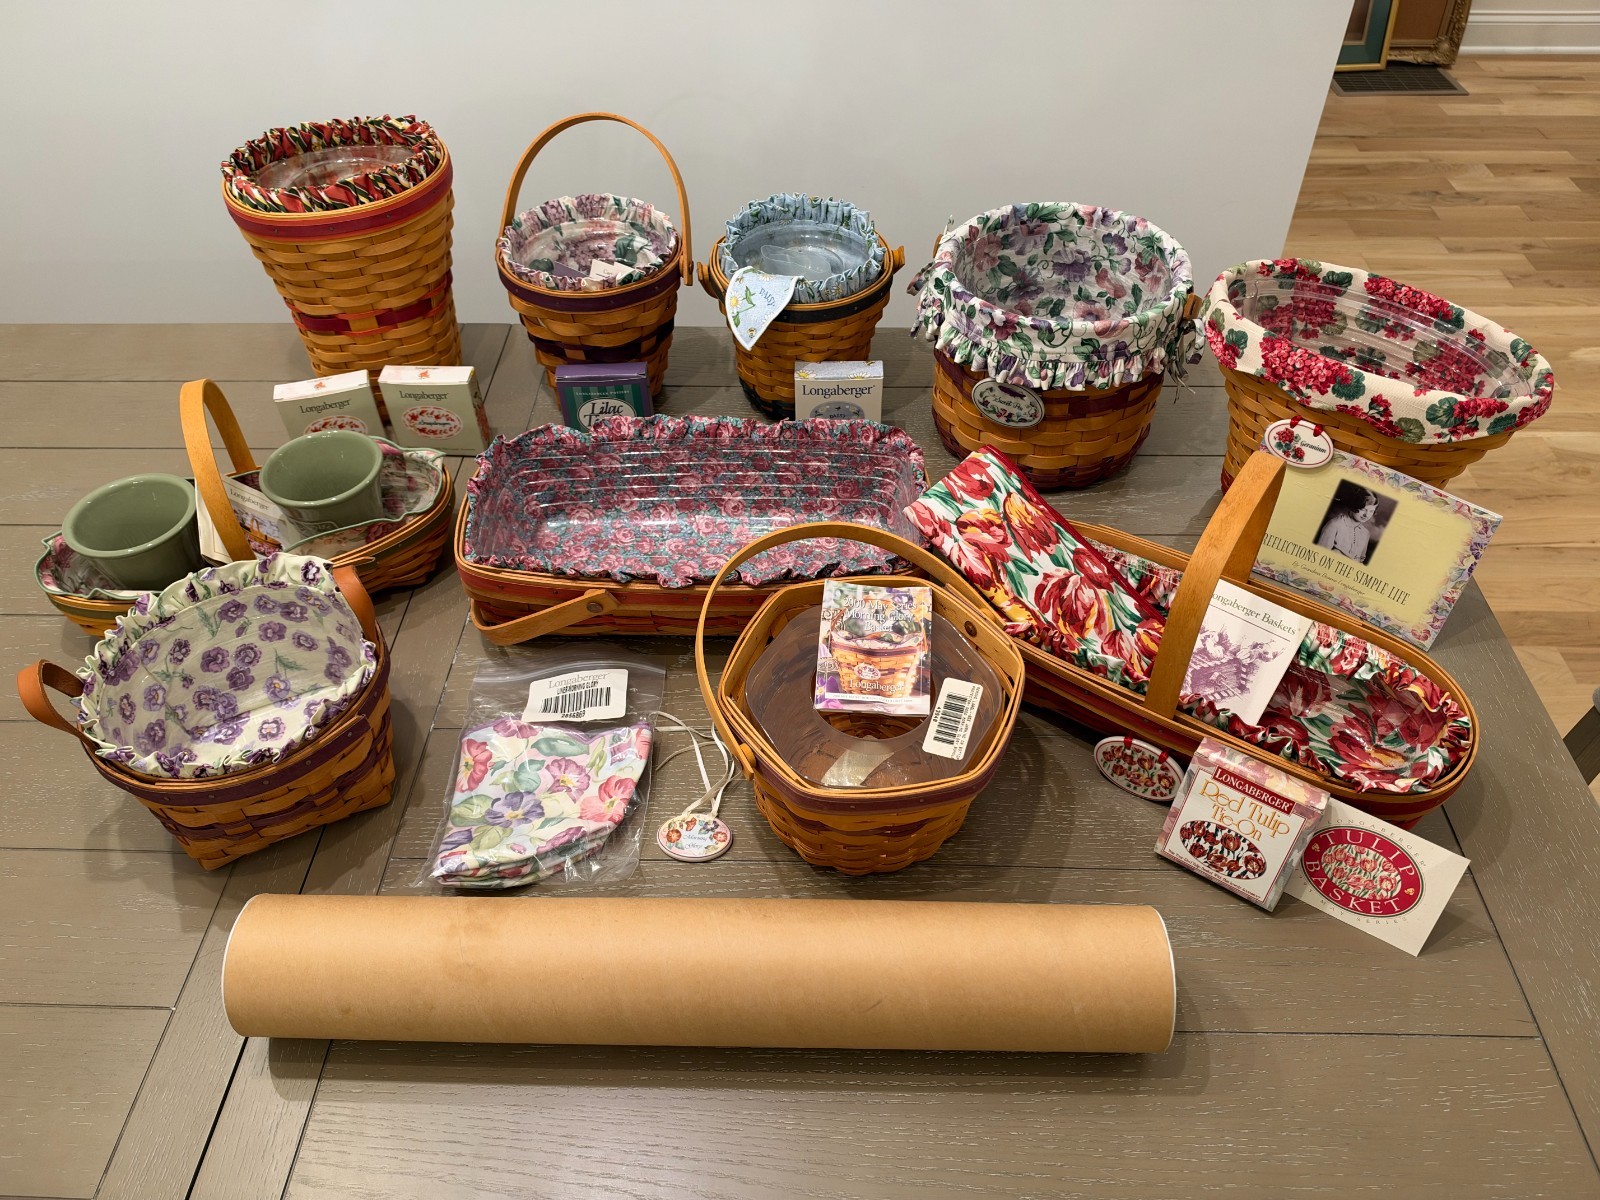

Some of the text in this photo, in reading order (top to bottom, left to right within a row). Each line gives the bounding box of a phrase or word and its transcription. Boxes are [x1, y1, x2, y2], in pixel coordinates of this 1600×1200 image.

[399, 390, 448, 401] Longaberger
[802, 385, 873, 398] Longaberger
[299, 399, 350, 414] Longaberger
[590, 402, 623, 415] Lilac
[1300, 440, 1327, 453] Geranium
[229, 488, 269, 510] Longaberger
[1319, 555, 1334, 570] ON
[1335, 561, 1354, 578] THE
[1354, 569, 1389, 597] SIMPLE
[1388, 586, 1411, 606] LIFE
[1212, 592, 1297, 635] ongaberger Baskets
[548, 673, 607, 689] Longaberger
[1215, 768, 1290, 812] LONGABERGER
[1199, 779, 1290, 838] Red Tulip
[1211, 804, 1262, 841] Tie-On
[1320, 829, 1415, 876] TULIP
[1305, 861, 1401, 914] BASKET
